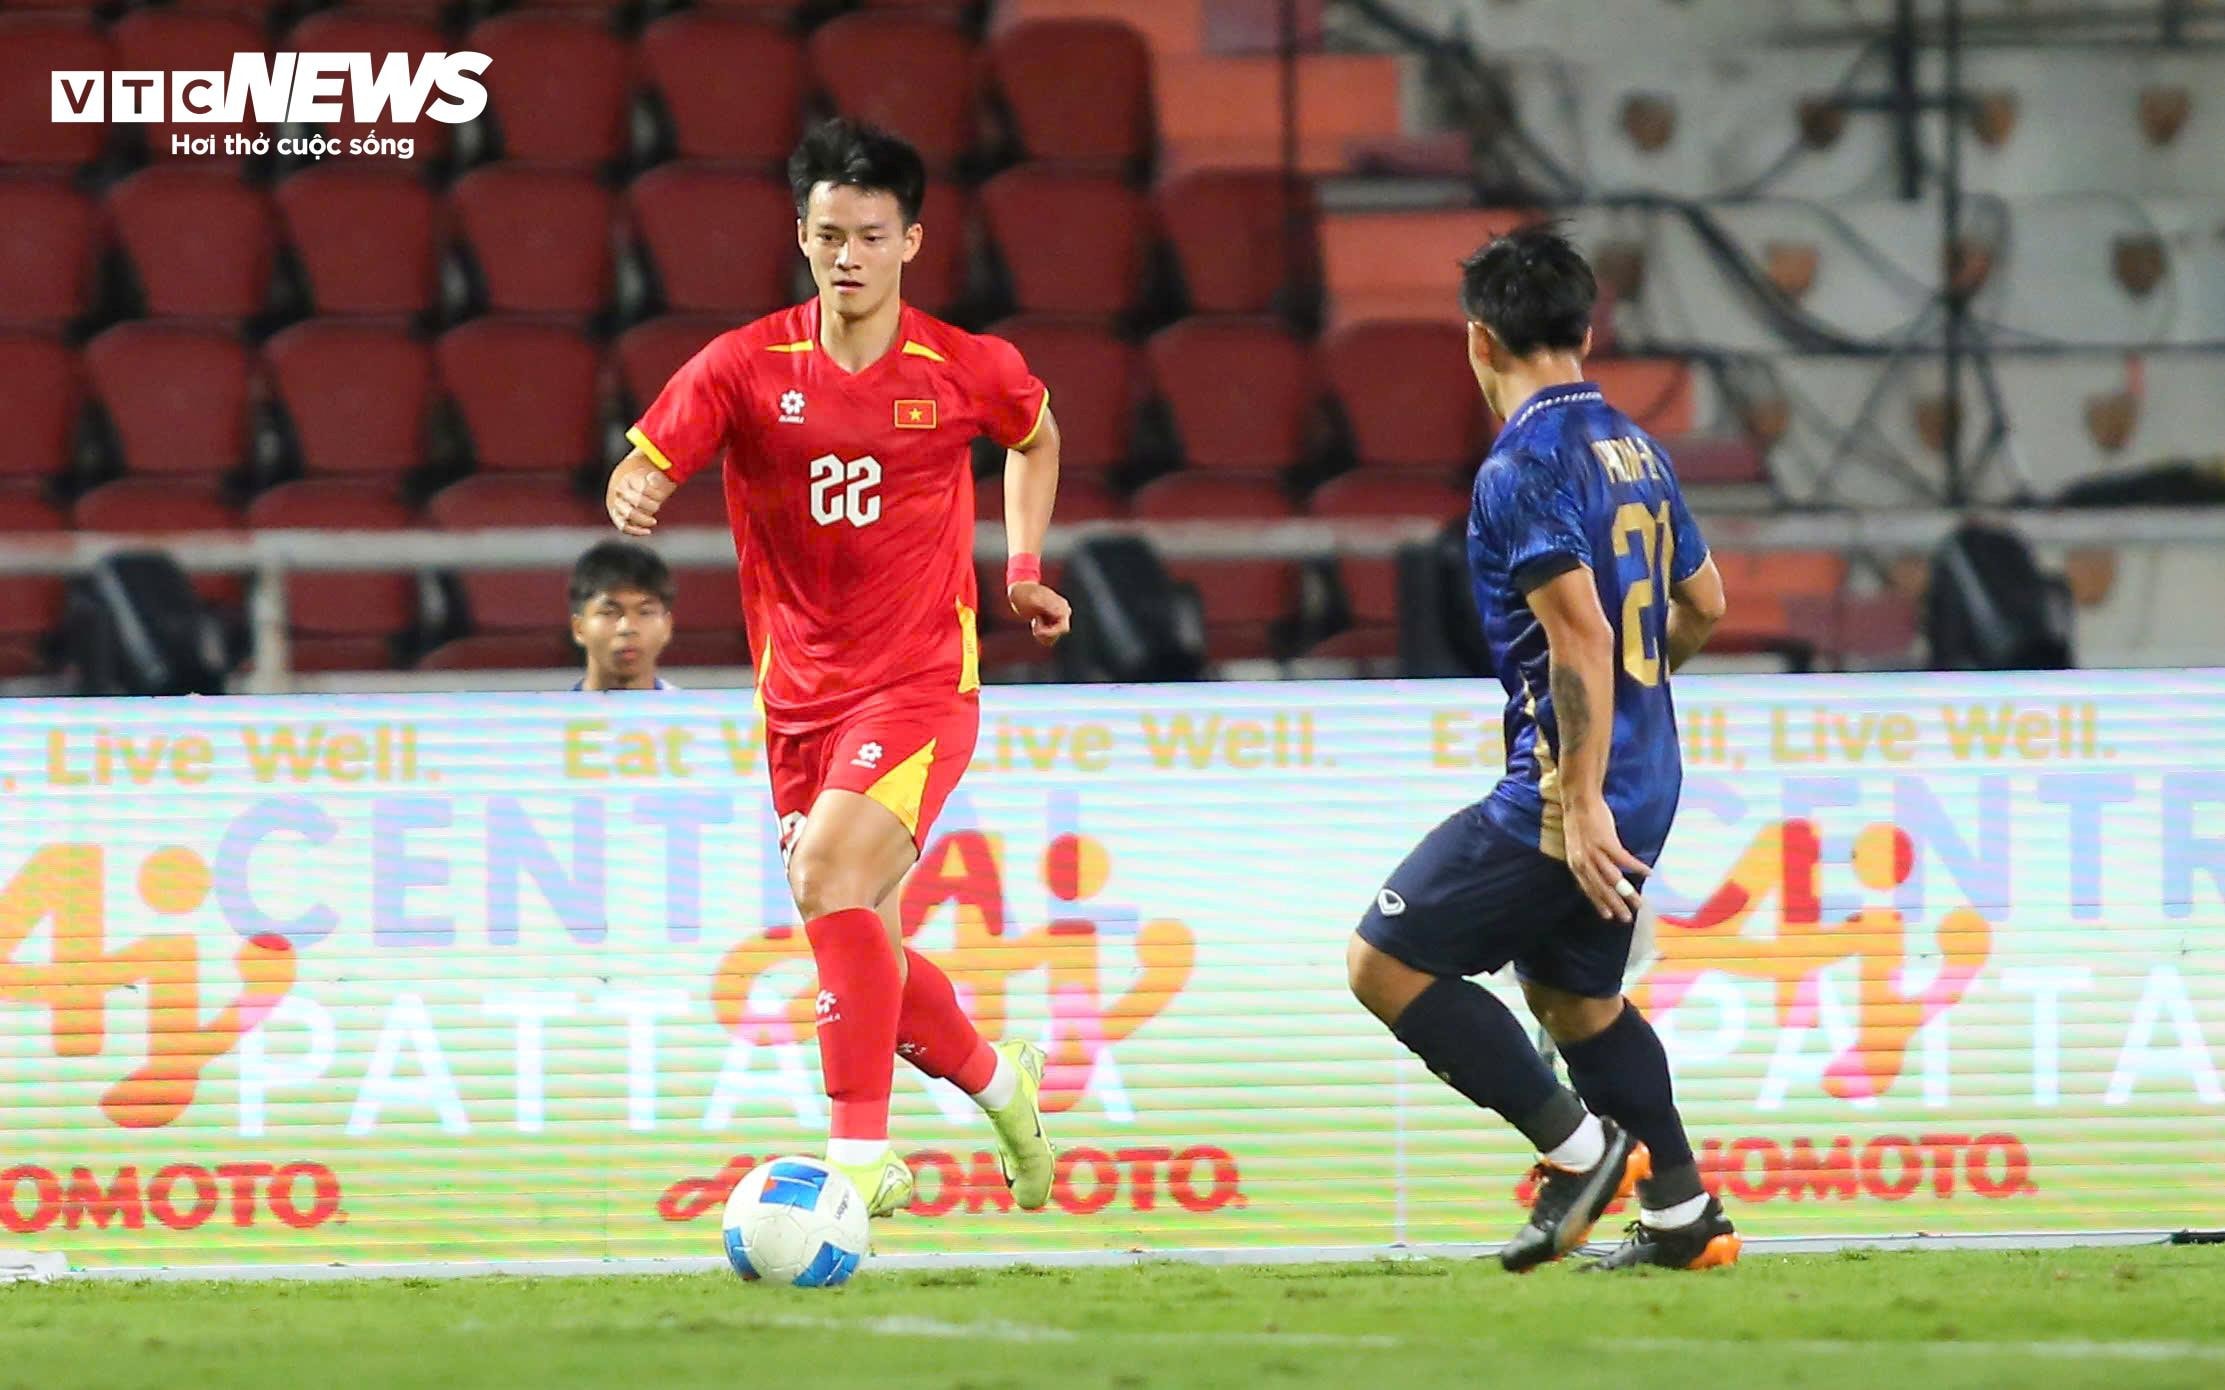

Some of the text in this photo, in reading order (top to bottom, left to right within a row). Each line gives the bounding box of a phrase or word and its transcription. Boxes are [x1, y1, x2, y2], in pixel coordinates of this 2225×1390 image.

[810, 453, 881, 528] 22
[47, 723, 441, 785] Live Well.
[563, 719, 694, 778] Eat
[970, 716, 1113, 772] ive
[1141, 711, 1336, 769] Well.
[1431, 710, 1504, 768] Ea
[1770, 704, 1917, 762] Live
[1941, 702, 2118, 760] Well.
